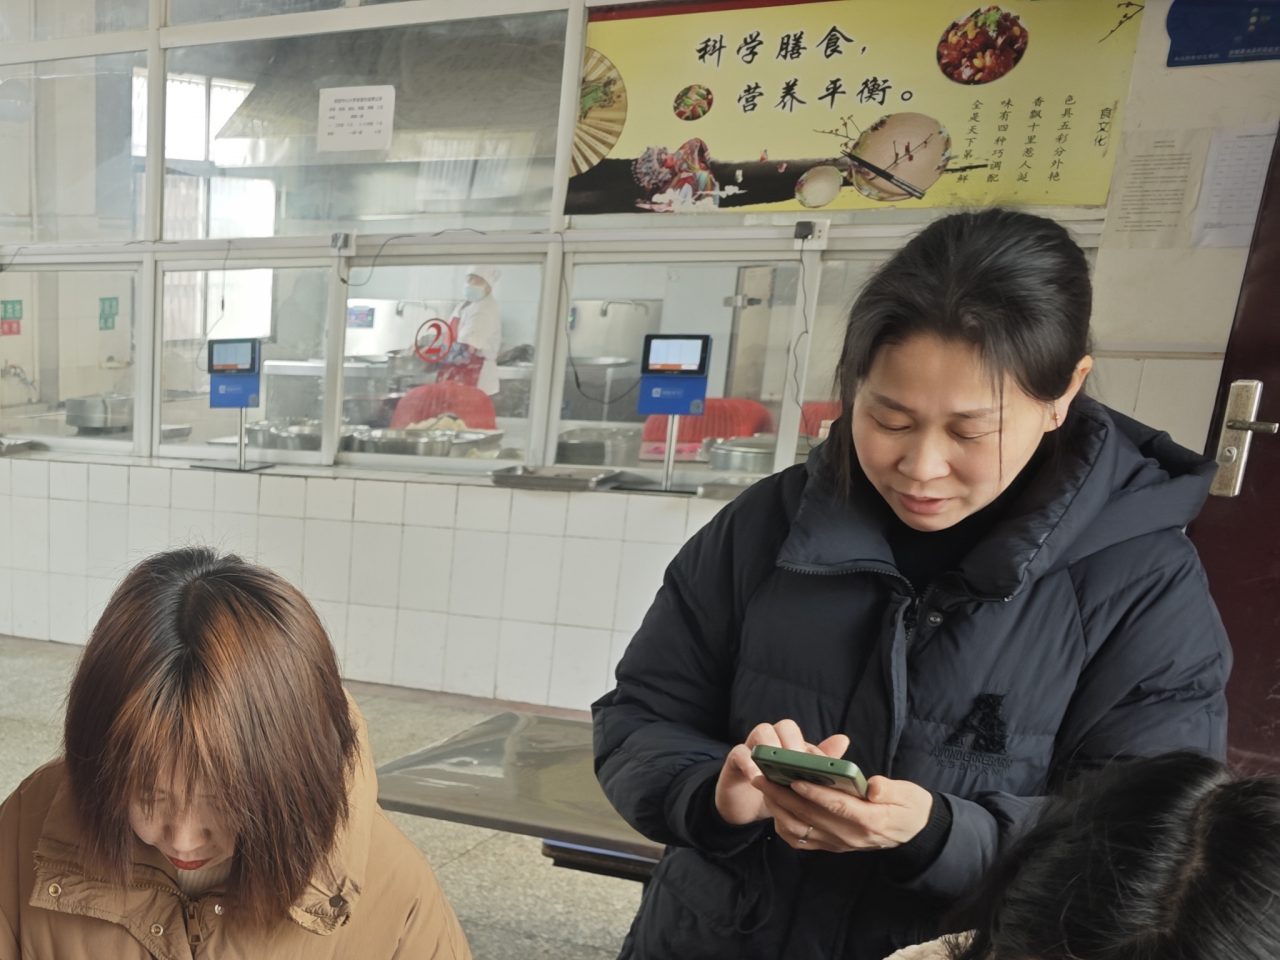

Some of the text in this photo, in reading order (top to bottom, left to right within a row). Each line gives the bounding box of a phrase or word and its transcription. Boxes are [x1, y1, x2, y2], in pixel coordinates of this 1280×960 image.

[695, 25, 868, 68] 科学膳食，
[736, 76, 915, 114] 营养平衡。
